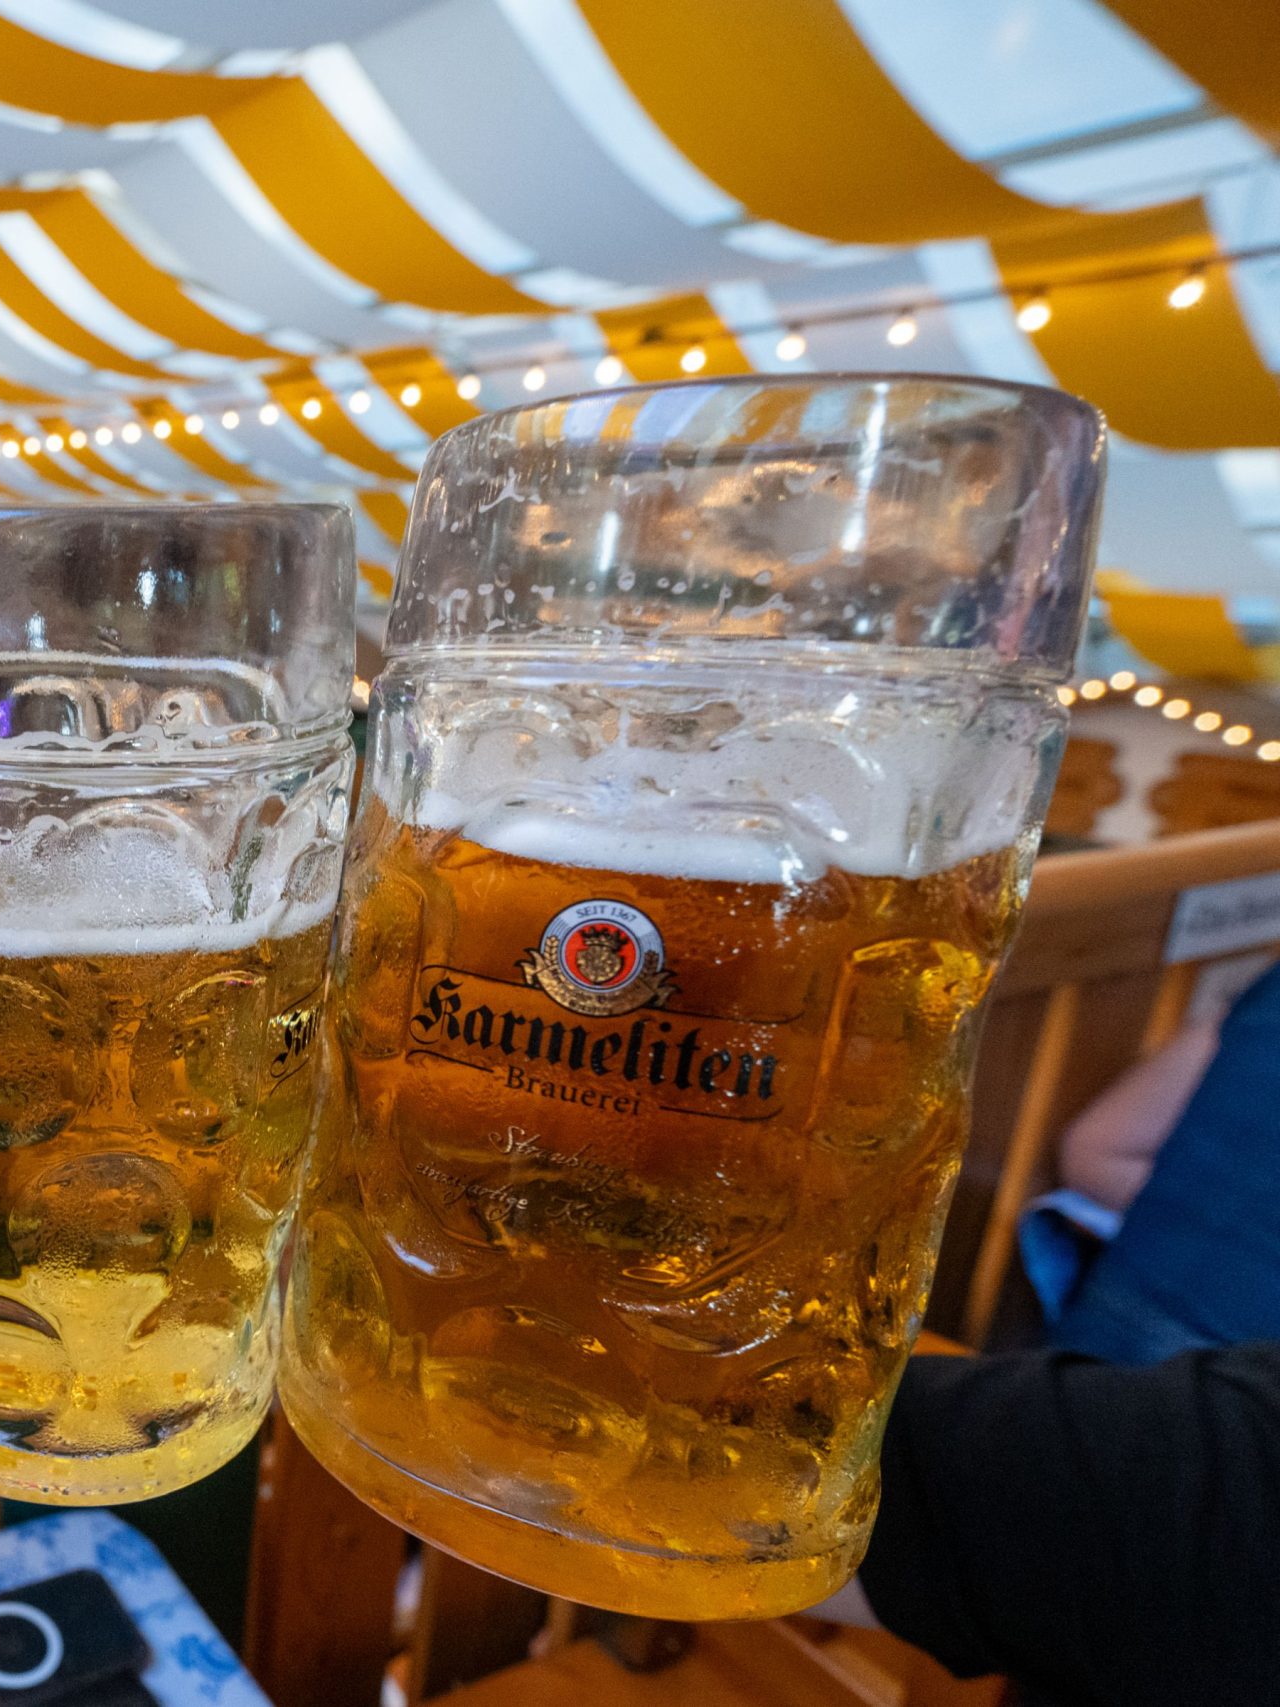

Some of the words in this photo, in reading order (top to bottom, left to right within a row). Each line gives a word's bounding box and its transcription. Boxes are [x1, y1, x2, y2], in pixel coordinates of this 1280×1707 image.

[575, 905, 607, 919] SEIT
[409, 977, 778, 1099] Karmeliten
[504, 1064, 641, 1116] Brauerei
